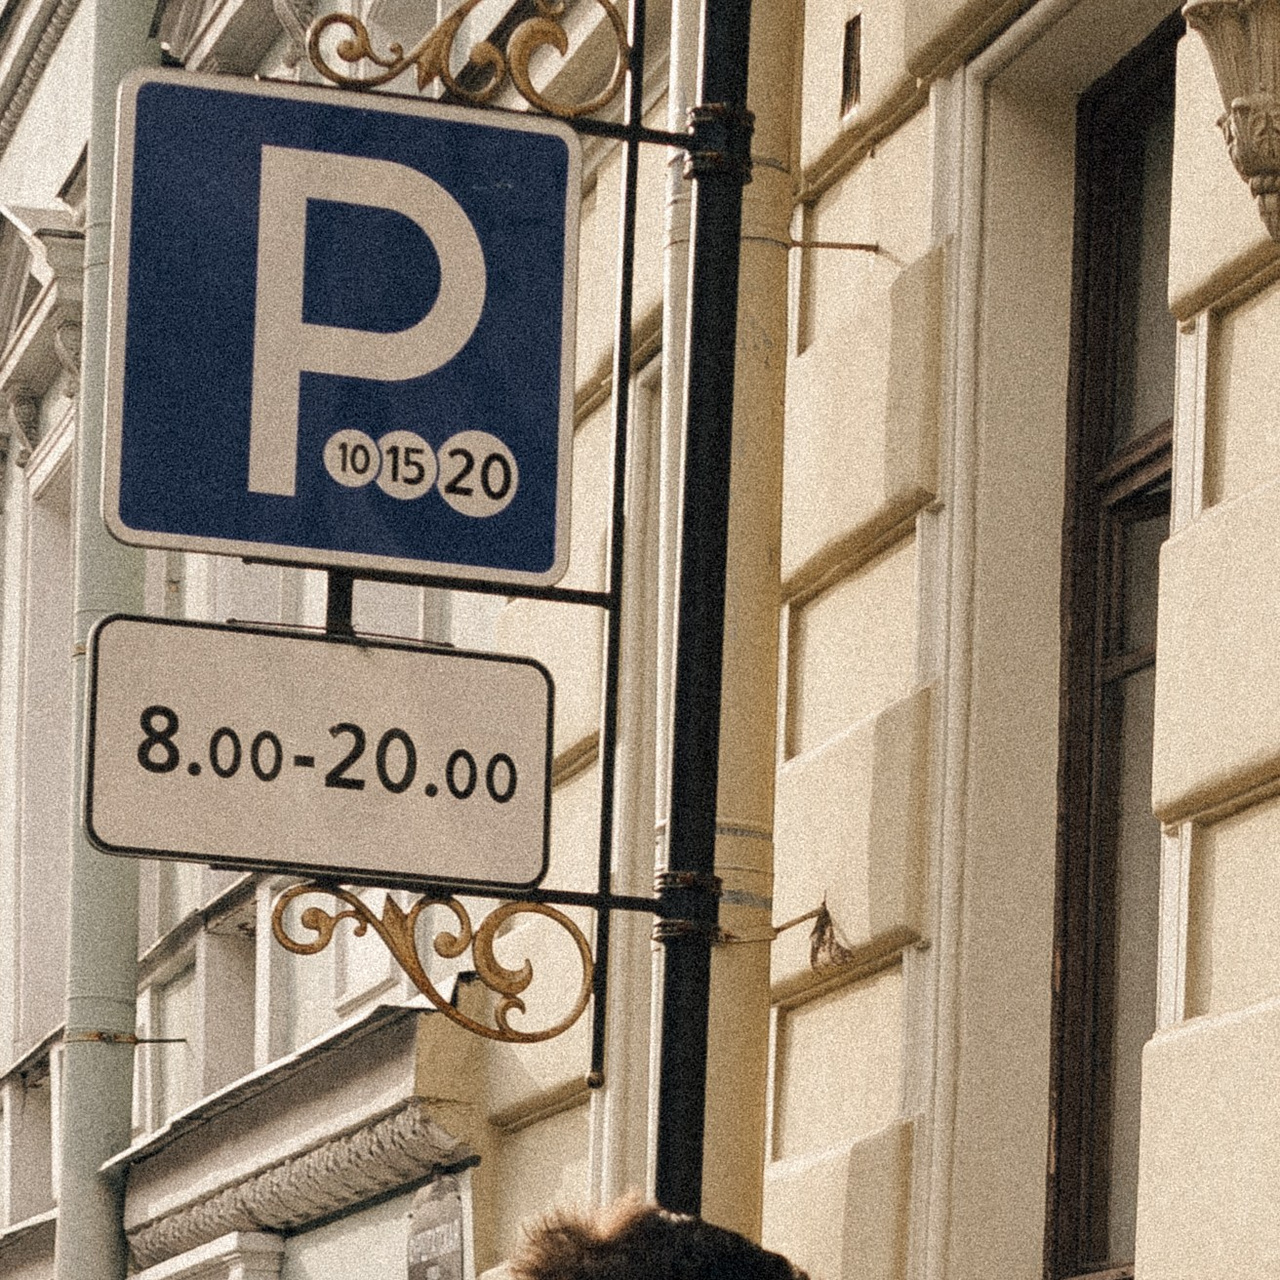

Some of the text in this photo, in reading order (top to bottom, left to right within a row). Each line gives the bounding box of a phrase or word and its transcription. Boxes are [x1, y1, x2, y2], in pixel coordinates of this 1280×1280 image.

[248, 144, 487, 497] P
[339, 442, 512, 500] 10 15 20
[137, 704, 518, 804] 8.00-20.00
